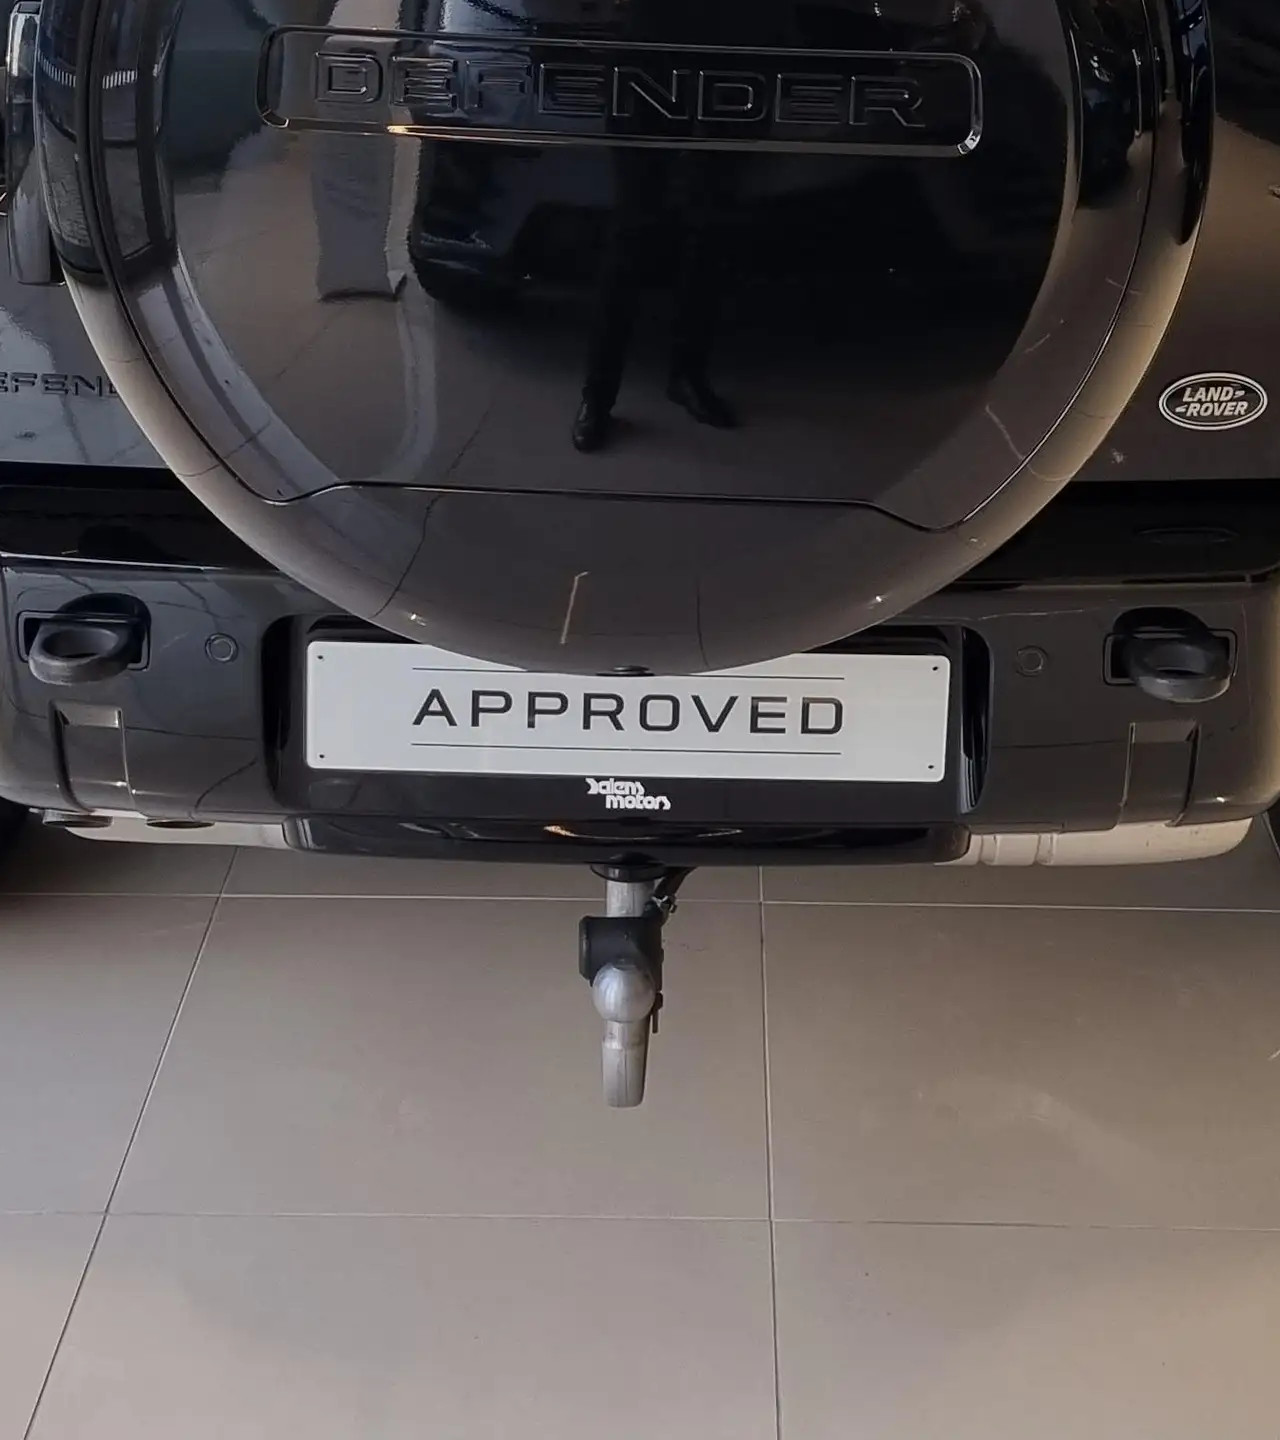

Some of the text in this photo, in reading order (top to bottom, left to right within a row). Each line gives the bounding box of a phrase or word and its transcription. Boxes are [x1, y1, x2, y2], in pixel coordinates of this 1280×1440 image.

[315, 51, 925, 128] DEFENDER
[1182, 386, 1234, 402] LAND
[1186, 401, 1249, 417] ROVER
[412, 688, 844, 735] APPROVED
[585, 777, 646, 795] Salens
[605, 794, 672, 810] motors
